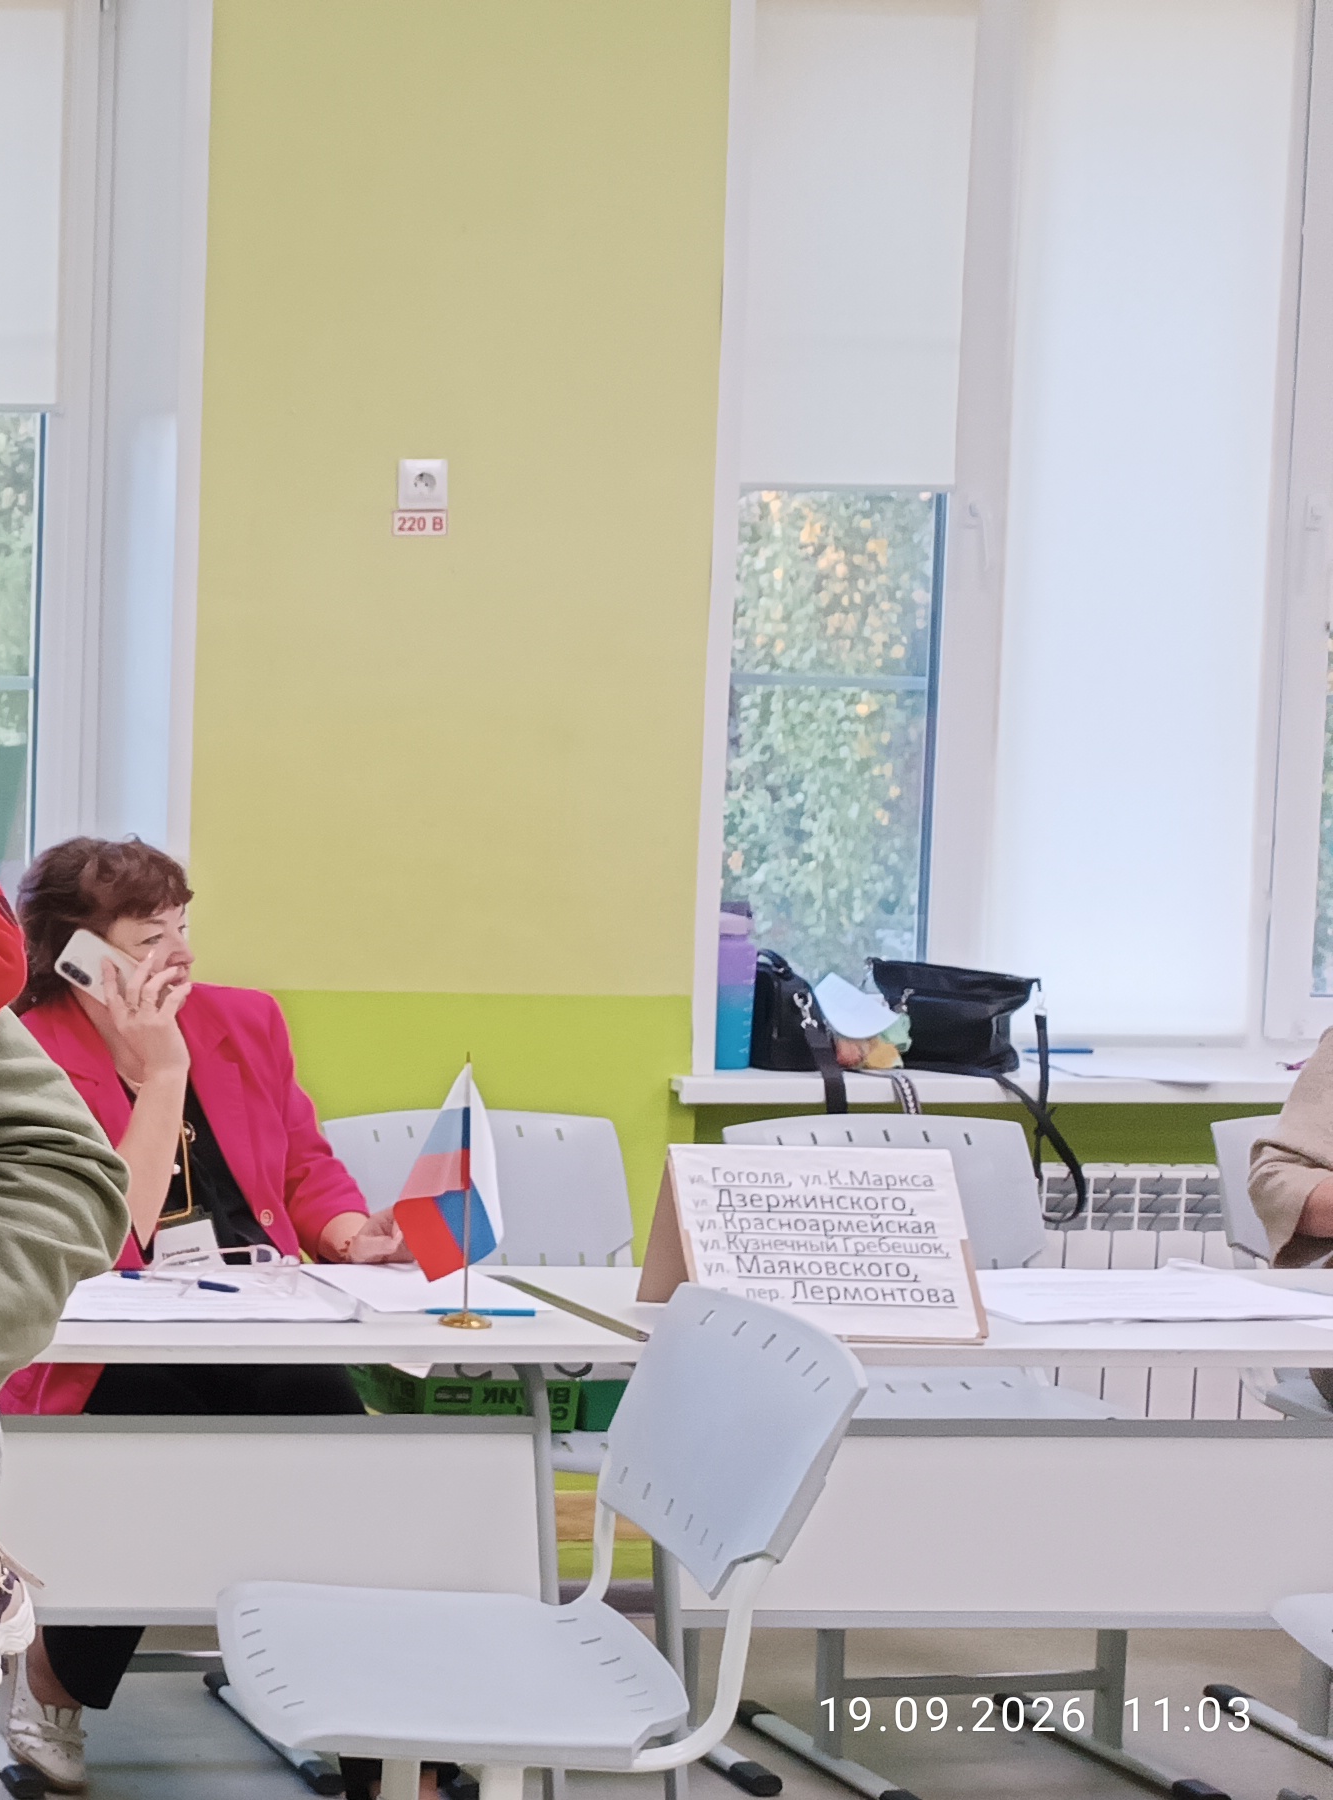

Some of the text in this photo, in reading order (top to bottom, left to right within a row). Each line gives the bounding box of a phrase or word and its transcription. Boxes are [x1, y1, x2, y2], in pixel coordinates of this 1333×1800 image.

[398, 516, 443, 531] 220 В
[716, 1188, 915, 1216] Дзержинского,
[843, 1235, 950, 1258] Гребешок,
[703, 1254, 918, 1282] ул. Маяковского,
[745, 1280, 955, 1304] пер. Лермонтова
